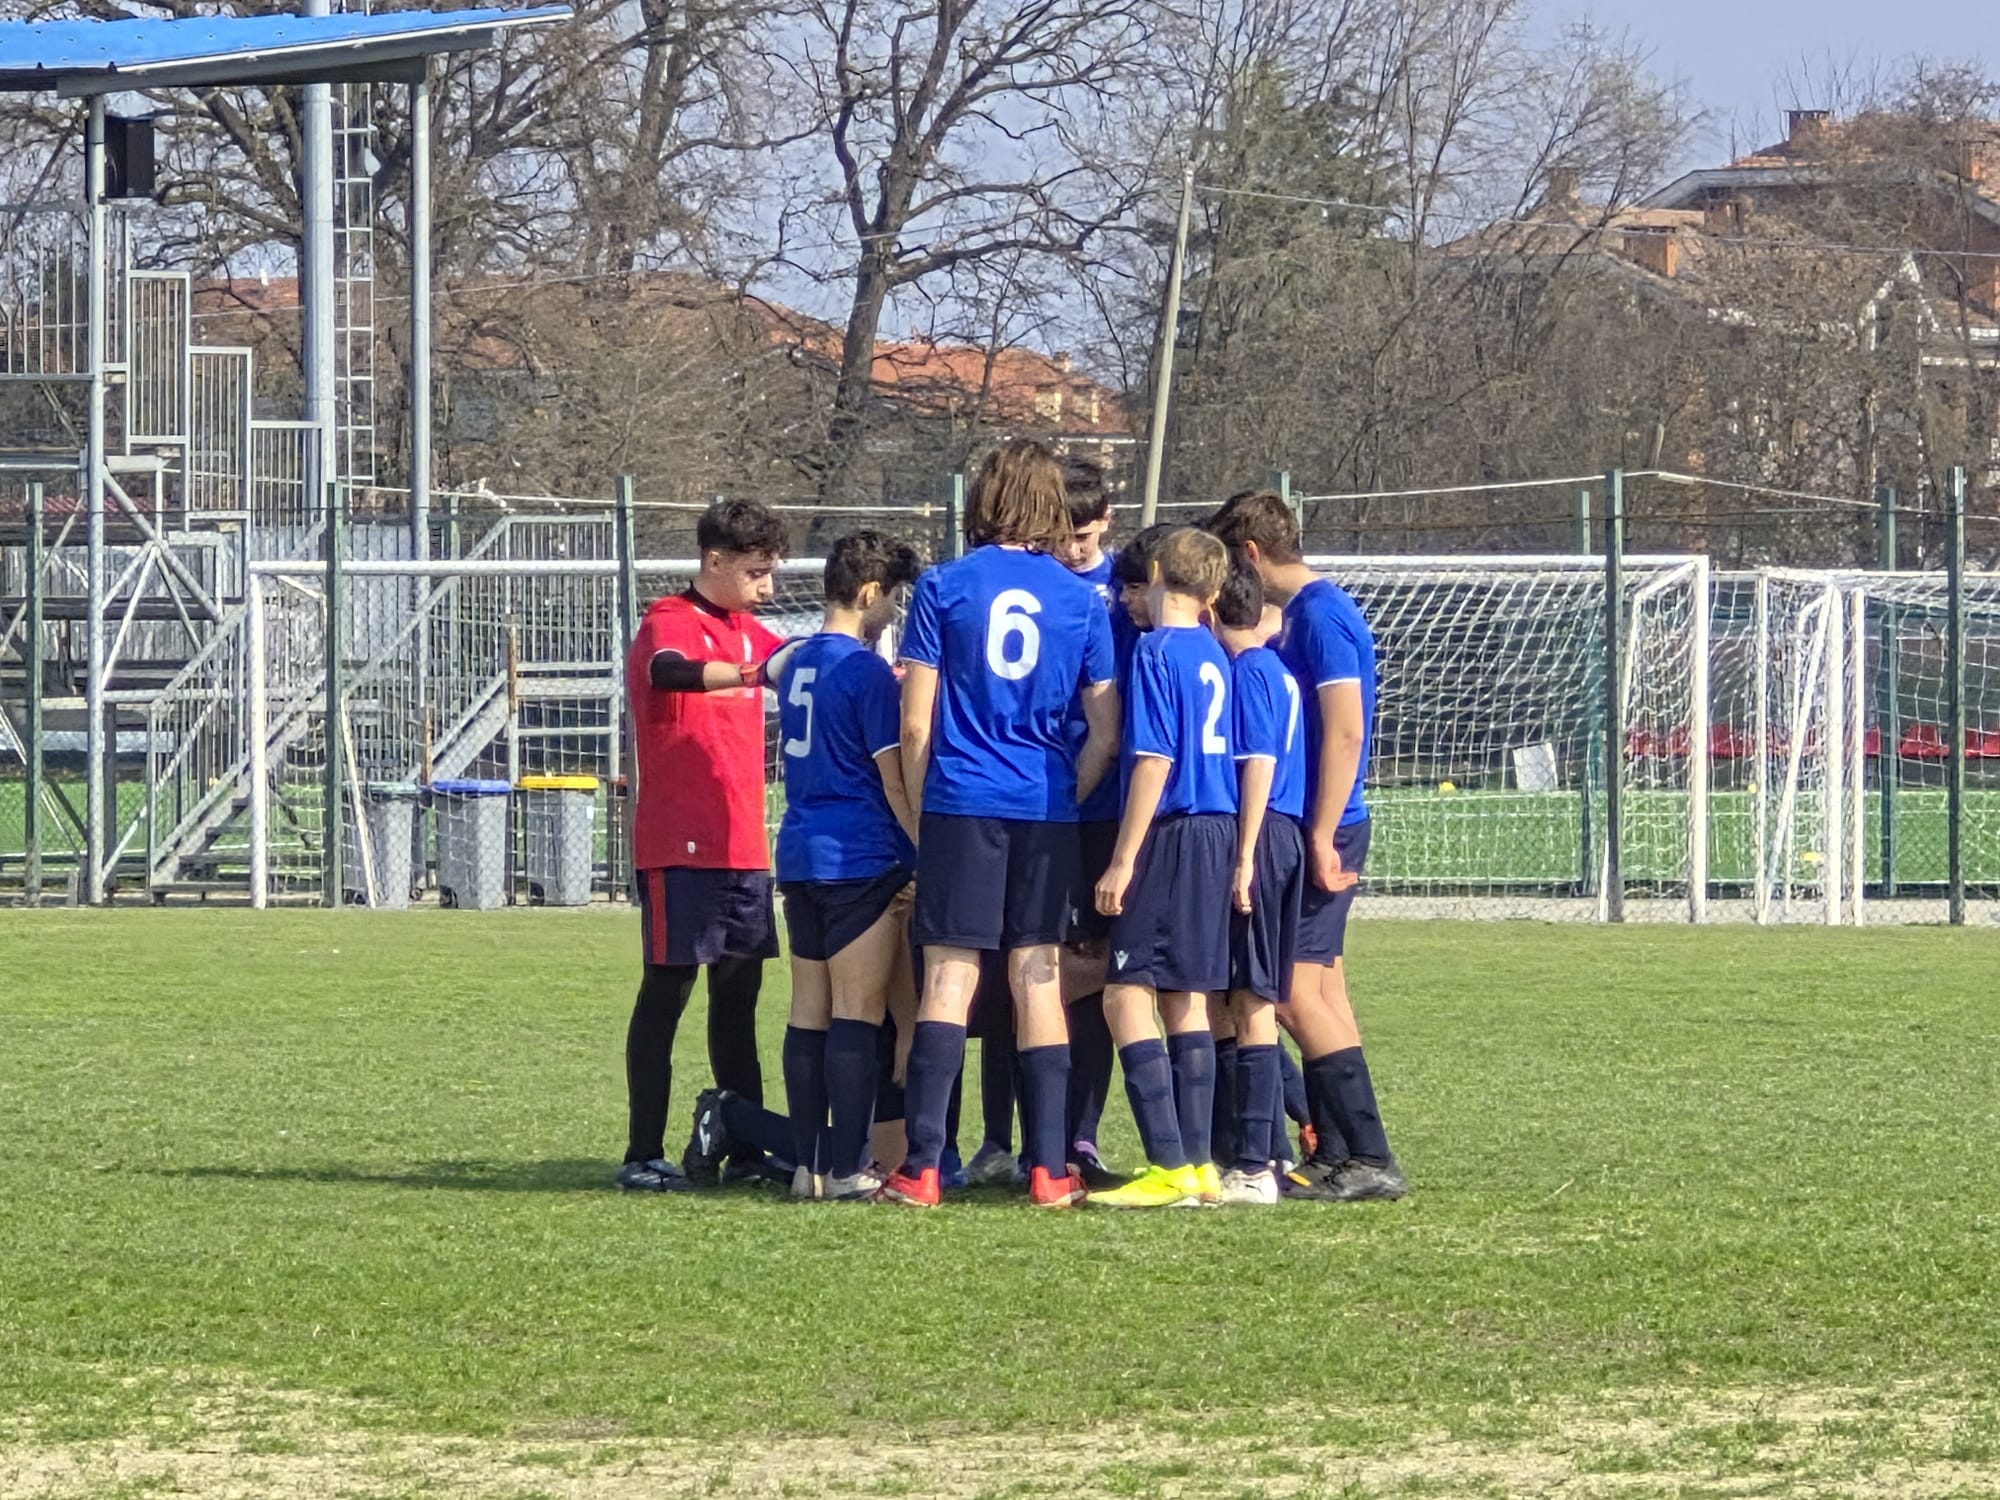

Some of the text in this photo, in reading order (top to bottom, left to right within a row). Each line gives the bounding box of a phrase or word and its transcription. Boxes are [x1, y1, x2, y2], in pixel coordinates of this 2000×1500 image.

[986, 588, 1042, 681] 6
[784, 667, 817, 758] 5
[1199, 661, 1227, 755] 2
